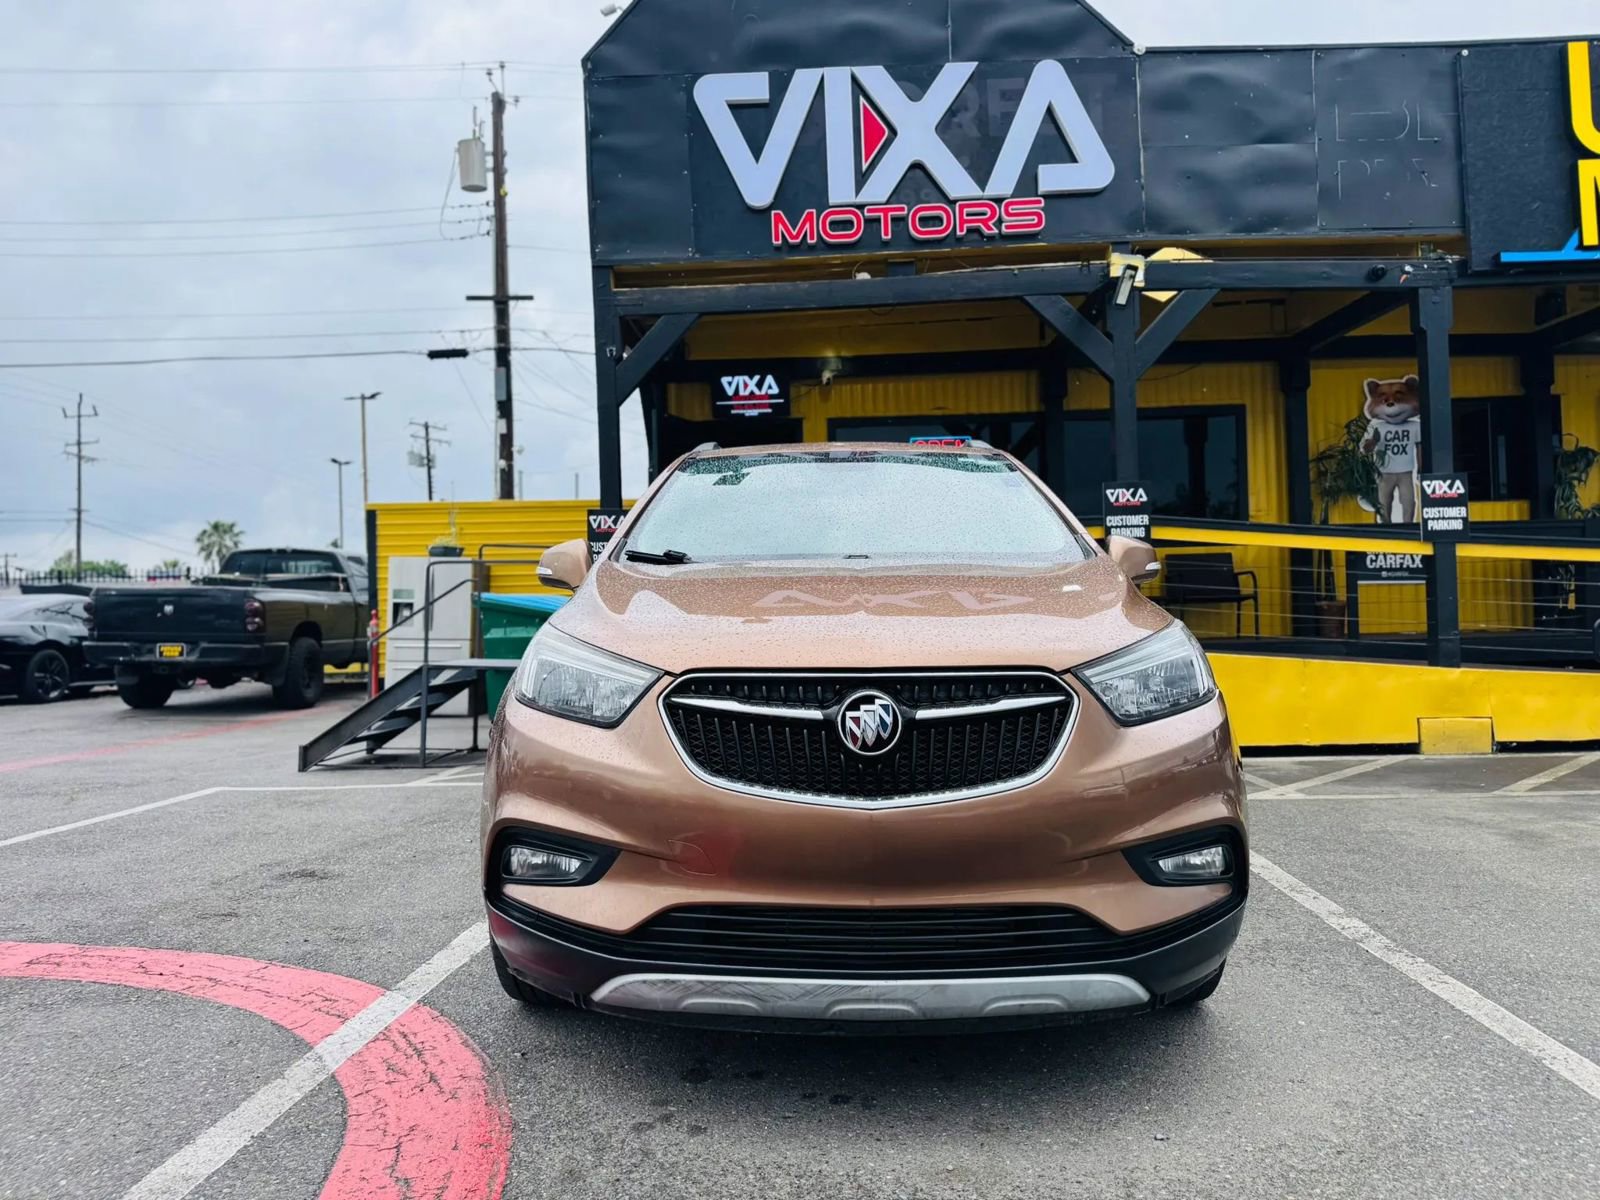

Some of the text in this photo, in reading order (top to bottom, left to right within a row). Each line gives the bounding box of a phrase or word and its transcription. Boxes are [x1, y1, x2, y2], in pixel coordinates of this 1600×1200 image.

[693, 58, 1115, 210] VIXA
[771, 196, 1046, 246] MOTORS
[720, 374, 780, 396] VIXA
[1384, 429, 1410, 443] CAR
[1384, 443, 1409, 456] FOX
[1421, 479, 1466, 495] VIXA
[1105, 487, 1148, 503] VIXA
[1423, 506, 1467, 519] CUSTOMER
[1106, 514, 1149, 527] CUSTOMER
[1427, 519, 1463, 531] PARKING
[1110, 527, 1146, 538] PARKING
[590, 541, 608, 553] CUST
[1366, 554, 1423, 569] CARFAX
